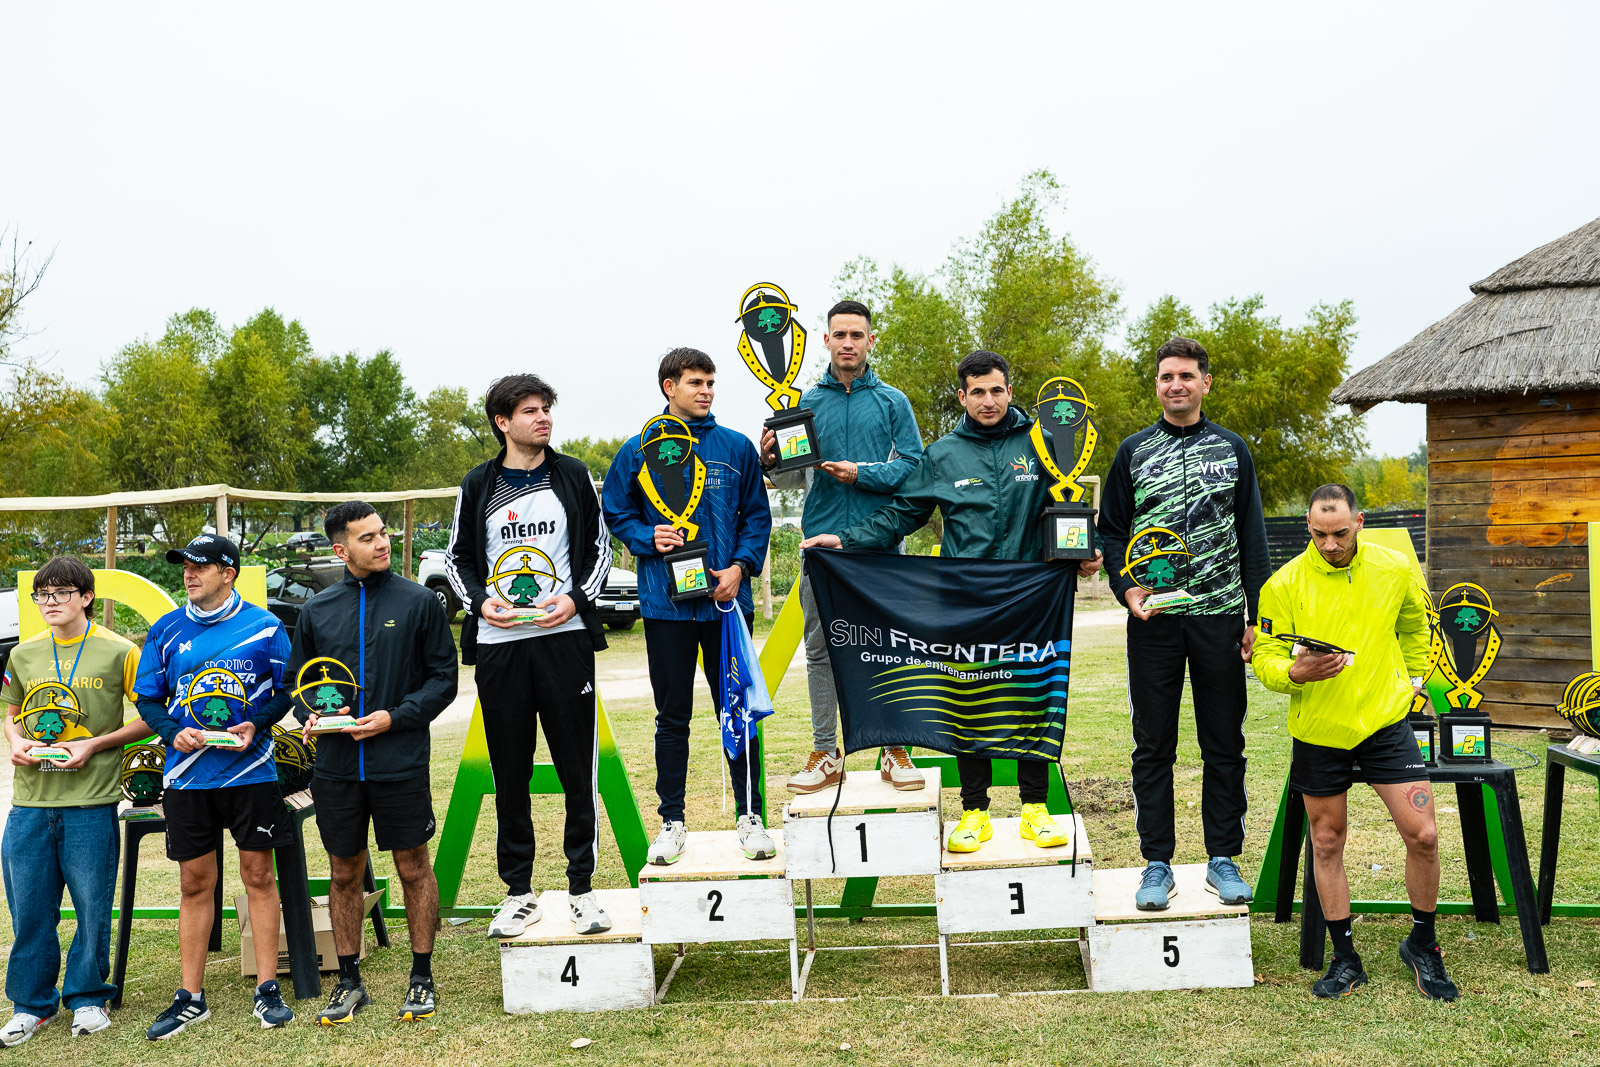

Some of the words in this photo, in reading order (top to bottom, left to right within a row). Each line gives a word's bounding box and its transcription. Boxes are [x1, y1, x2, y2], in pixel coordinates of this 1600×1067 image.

[787, 435, 798, 456] 1
[1198, 460, 1229, 478] VRT
[501, 520, 556, 539] ATENAS
[1066, 526, 1081, 548] 3
[685, 568, 697, 589] 2
[830, 619, 883, 647] SIN
[889, 628, 1058, 664] FRONTERA
[204, 658, 254, 671] SPORTIVO
[860, 651, 902, 665] Grupo
[905, 655, 922, 666] de
[924, 659, 1013, 681] entrenamiento
[1462, 734, 1477, 754] 2
[855, 822, 868, 863] 1
[707, 889, 725, 922] 2
[1008, 881, 1025, 915] 3
[1163, 935, 1180, 968] 5
[560, 955, 580, 987] 4
